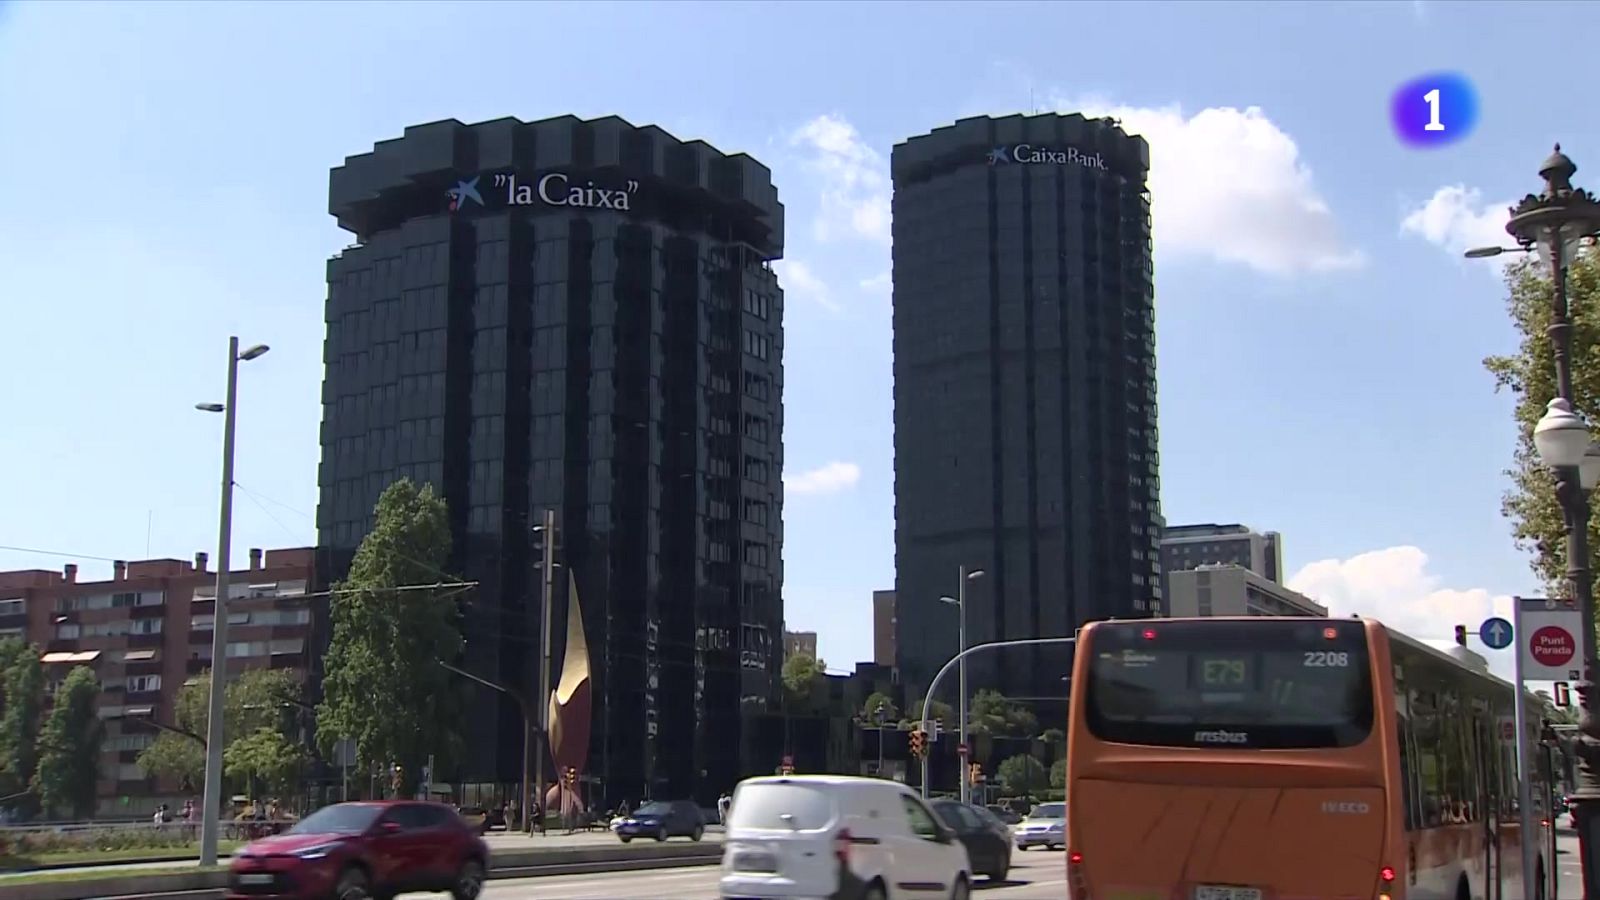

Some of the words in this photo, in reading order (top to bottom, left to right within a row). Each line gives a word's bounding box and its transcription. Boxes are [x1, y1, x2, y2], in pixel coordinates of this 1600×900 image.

[1540, 636, 1565, 645] Punt
[1535, 645, 1572, 655] Parada
[1303, 652, 1348, 667] 2208
[1321, 801, 1369, 813] IVECO
